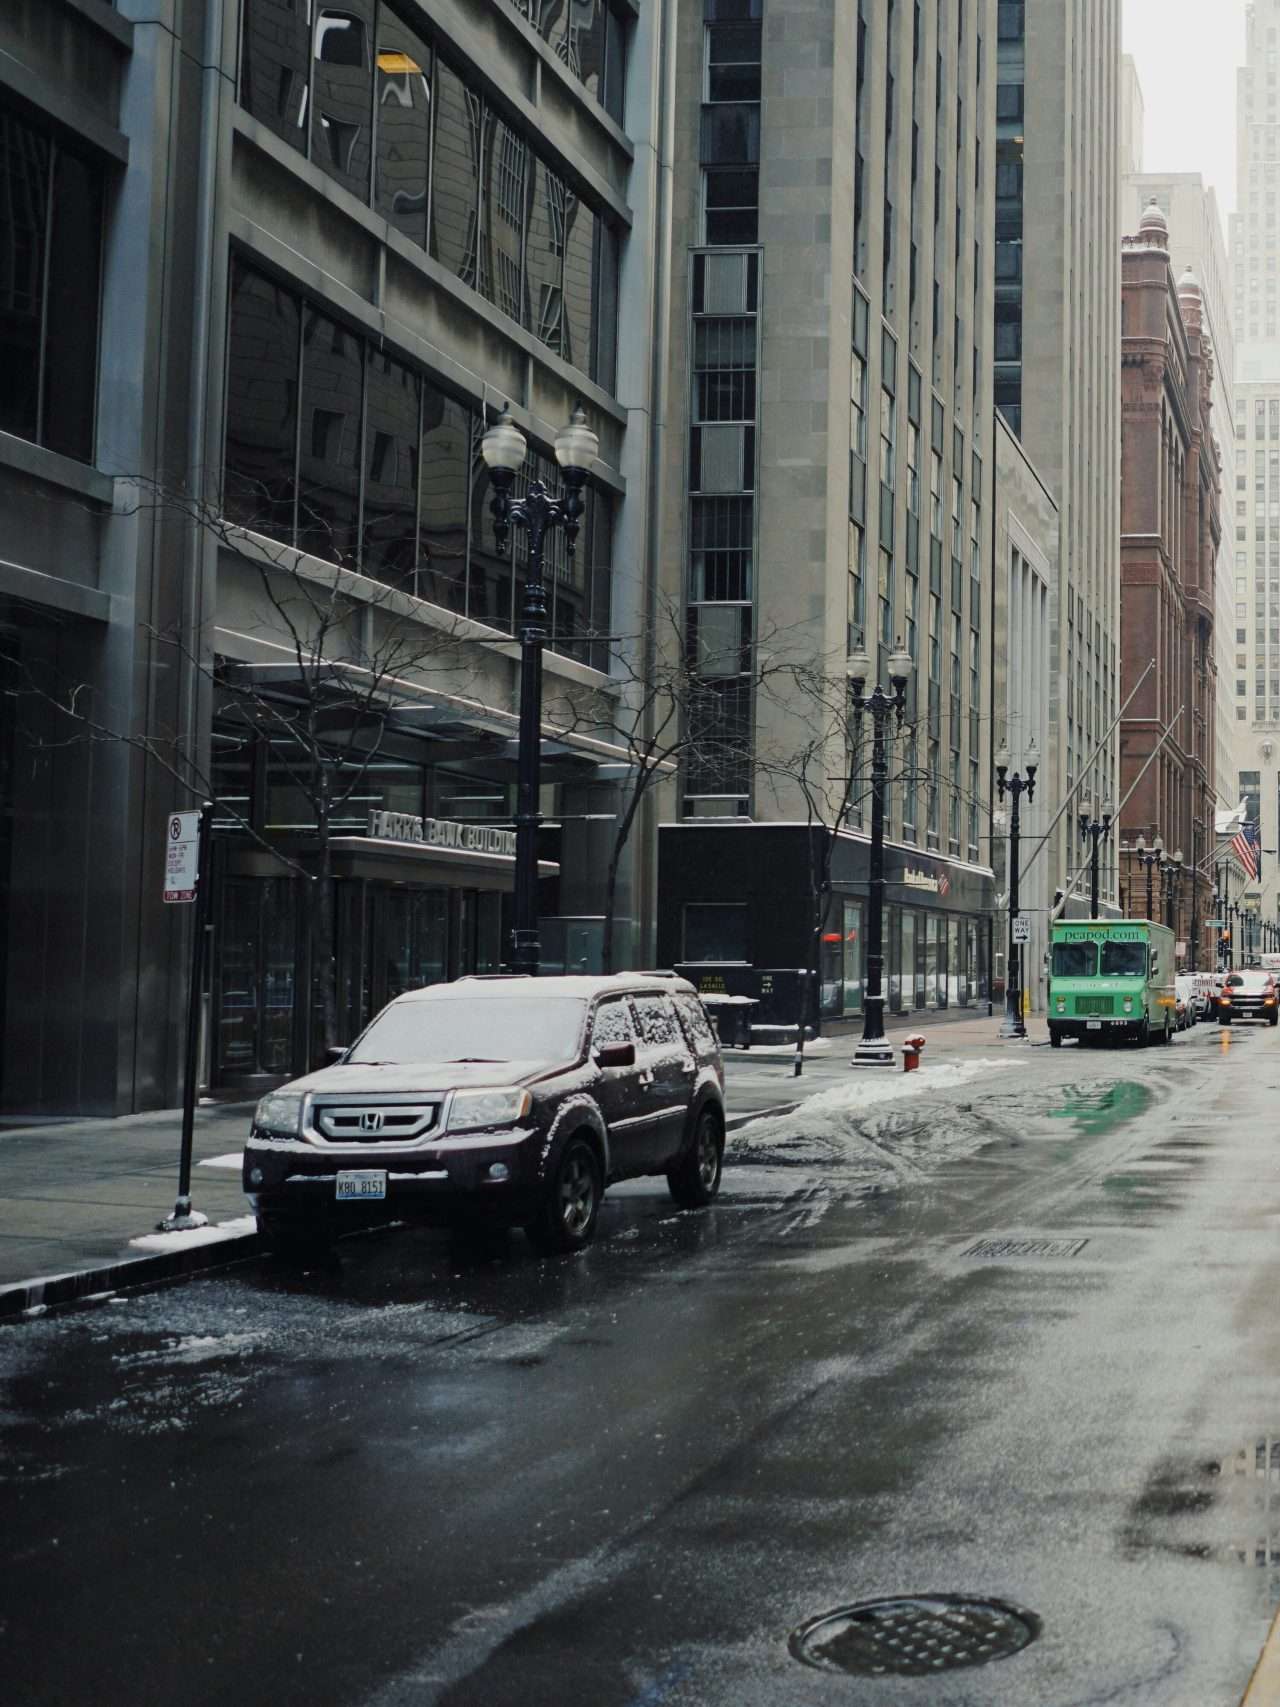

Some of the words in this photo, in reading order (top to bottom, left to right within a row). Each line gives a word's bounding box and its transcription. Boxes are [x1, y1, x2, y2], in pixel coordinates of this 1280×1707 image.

[368, 808, 423, 842] HARRIS
[424, 817, 464, 848] BANK
[465, 824, 517, 855] BUILDIN
[1065, 929, 1139, 942] peapod.com
